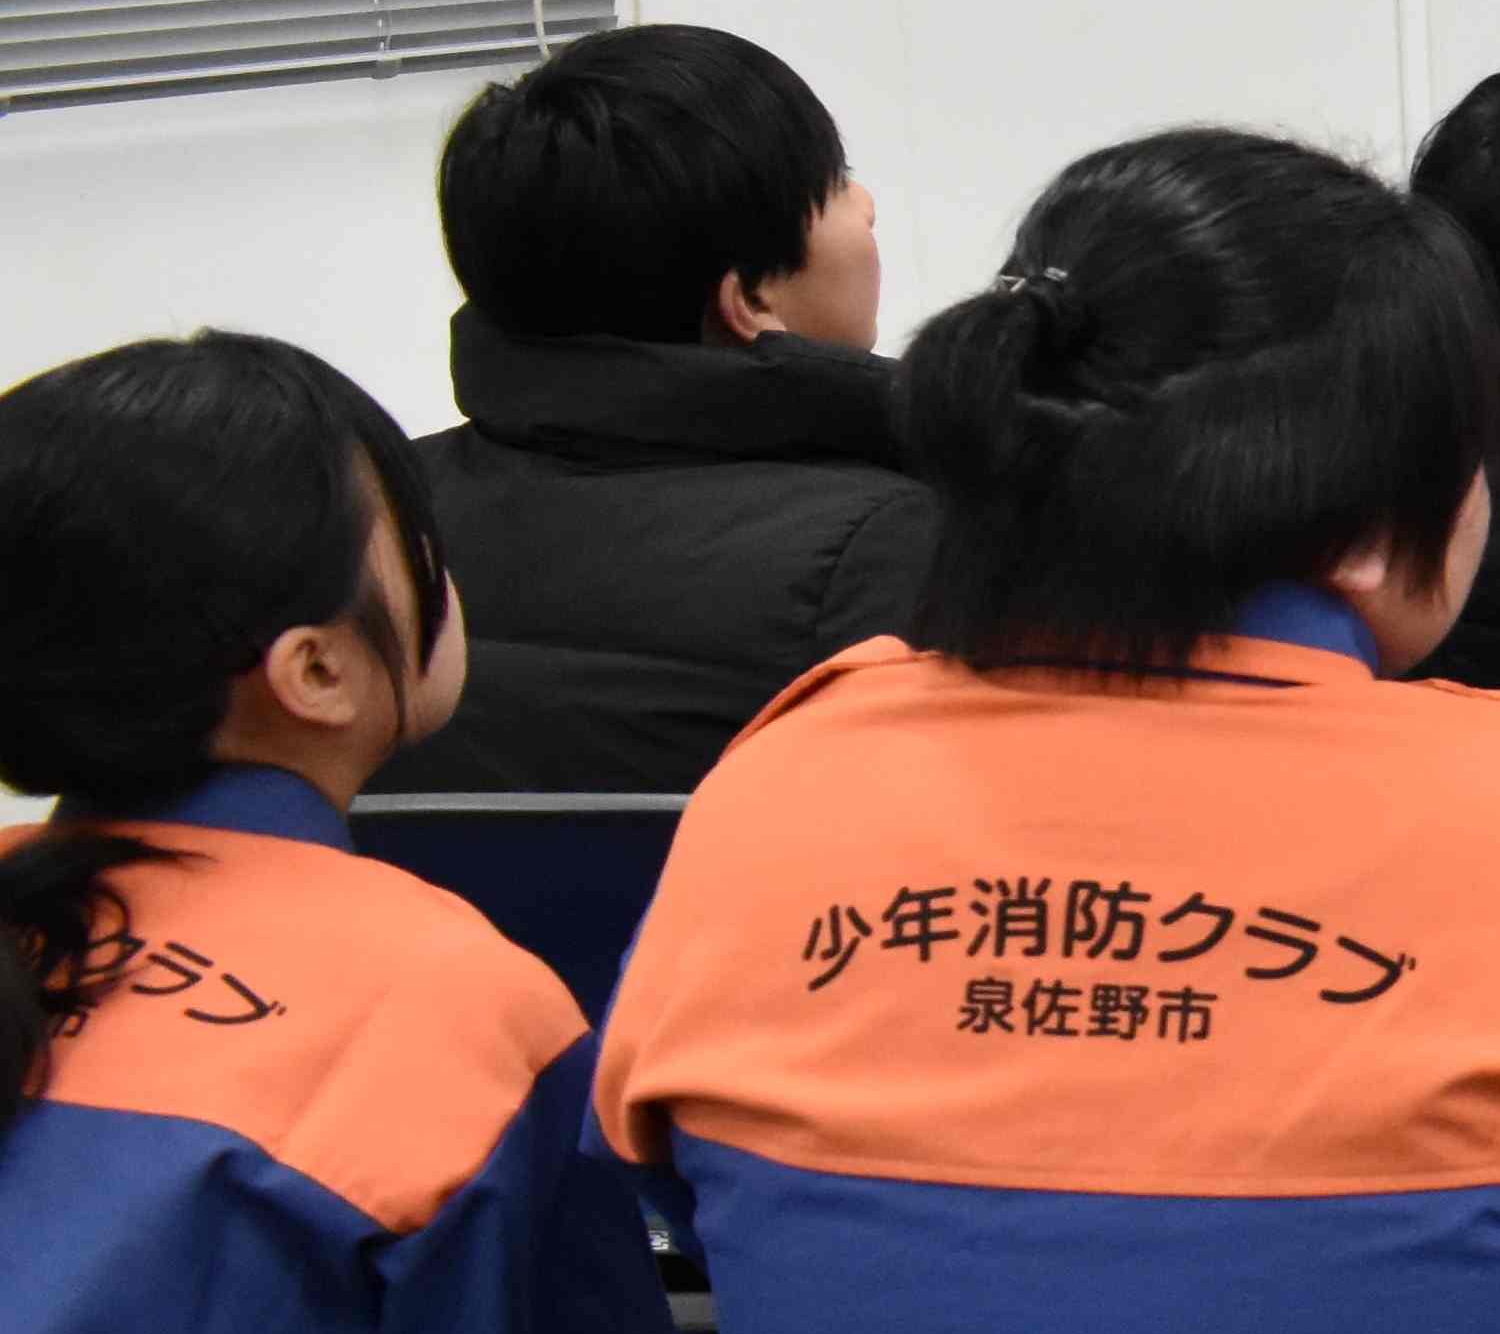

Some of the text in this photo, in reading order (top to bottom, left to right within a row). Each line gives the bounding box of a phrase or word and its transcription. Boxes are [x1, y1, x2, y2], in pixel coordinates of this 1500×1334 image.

[802, 876, 1417, 1007] 少年消防クラブ
[957, 976, 1219, 1044] 泉佐野市
